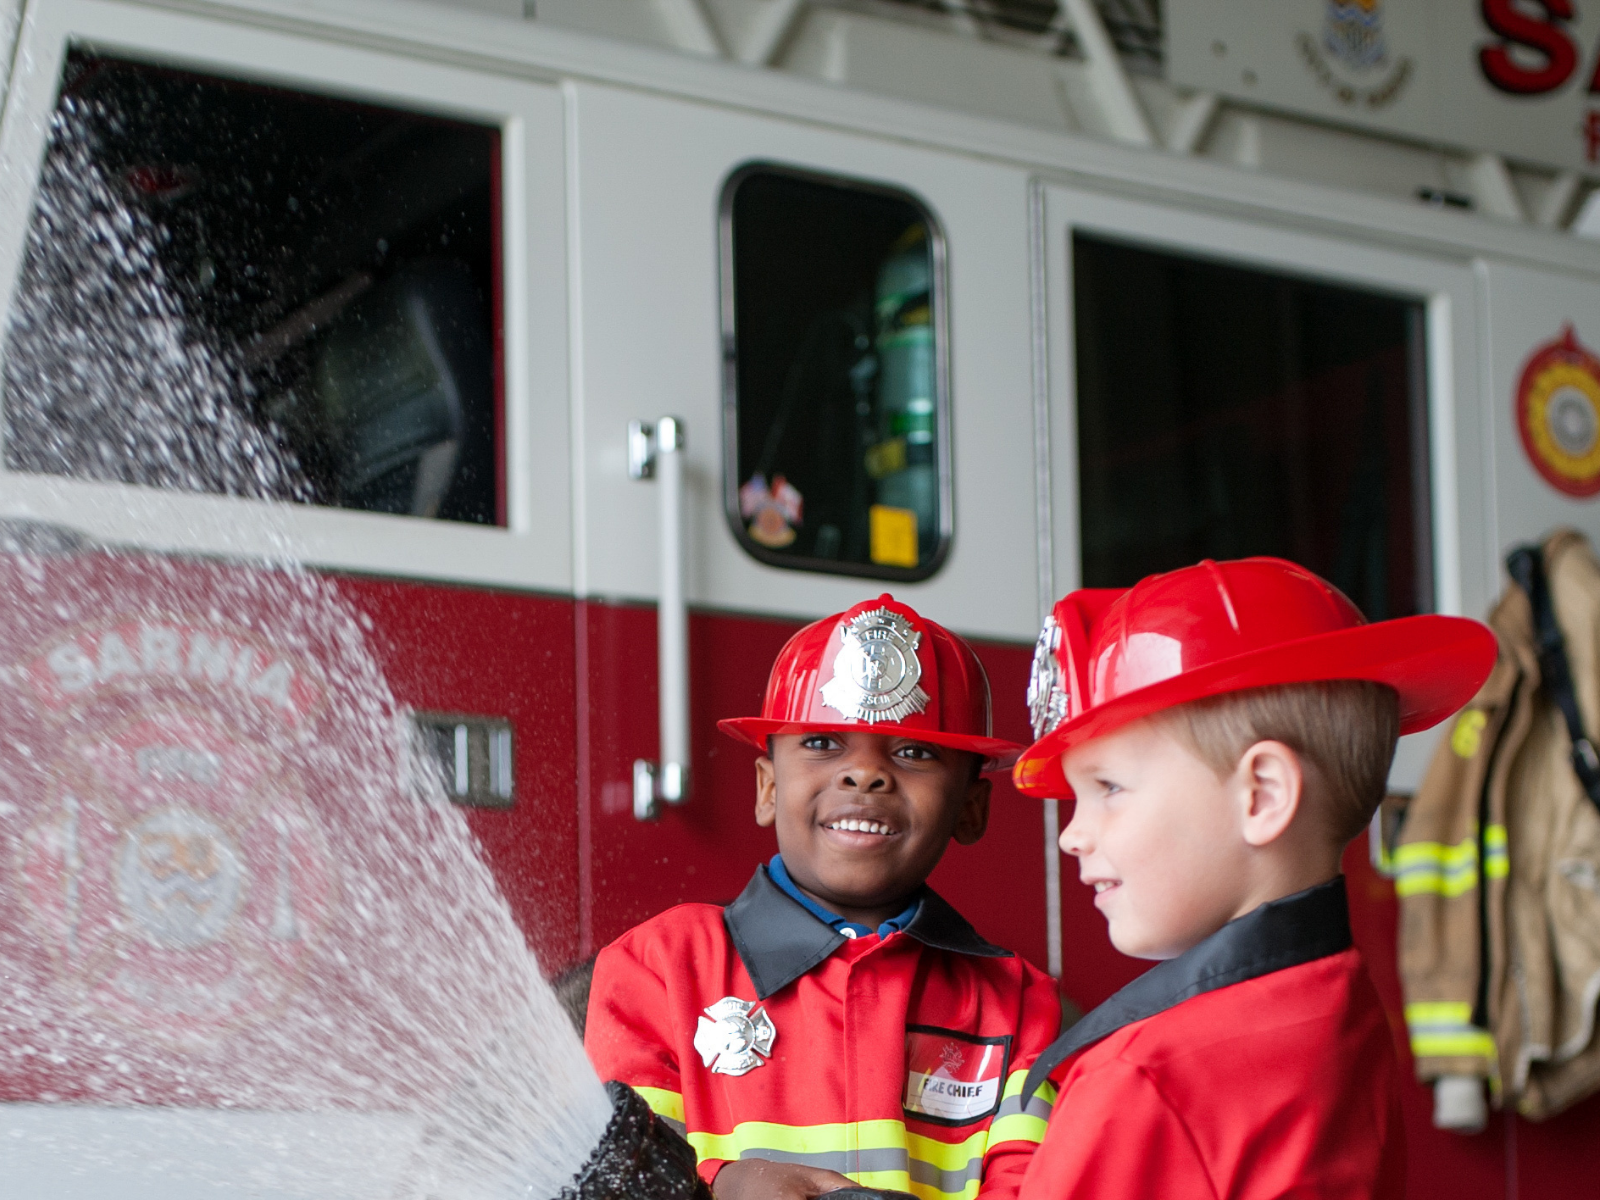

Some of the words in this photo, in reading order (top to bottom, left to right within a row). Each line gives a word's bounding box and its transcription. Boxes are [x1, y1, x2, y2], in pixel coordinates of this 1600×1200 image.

[1480, 0, 1600, 95] S
[864, 629, 897, 641] FIRE
[47, 624, 294, 706] SARNIA
[947, 1083, 984, 1098] CHIEF
